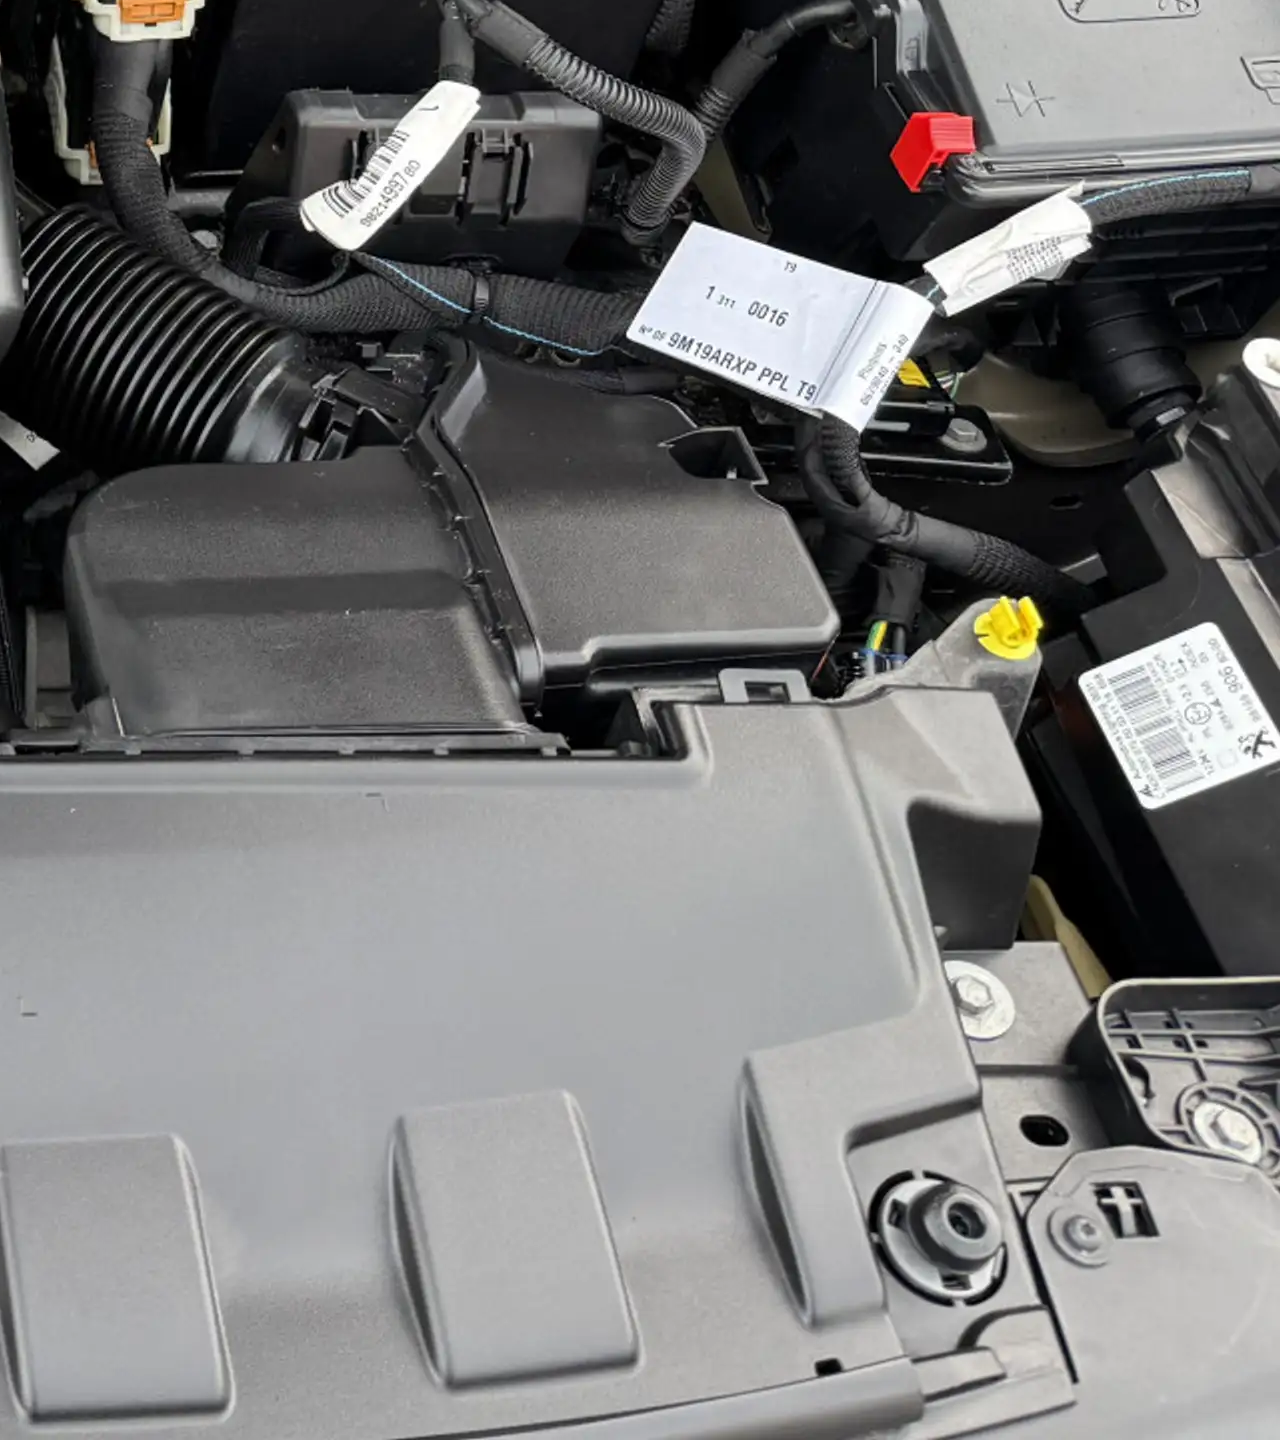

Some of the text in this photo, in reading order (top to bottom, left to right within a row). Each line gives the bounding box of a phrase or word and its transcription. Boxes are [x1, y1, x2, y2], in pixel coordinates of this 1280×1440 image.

[783, 260, 797, 273] T9
[705, 285, 715, 300] 1
[747, 300, 789, 328] 0016
[667, 331, 758, 376] 9M19ARXP
[758, 366, 791, 392] PPL
[796, 380, 818, 402] T9
